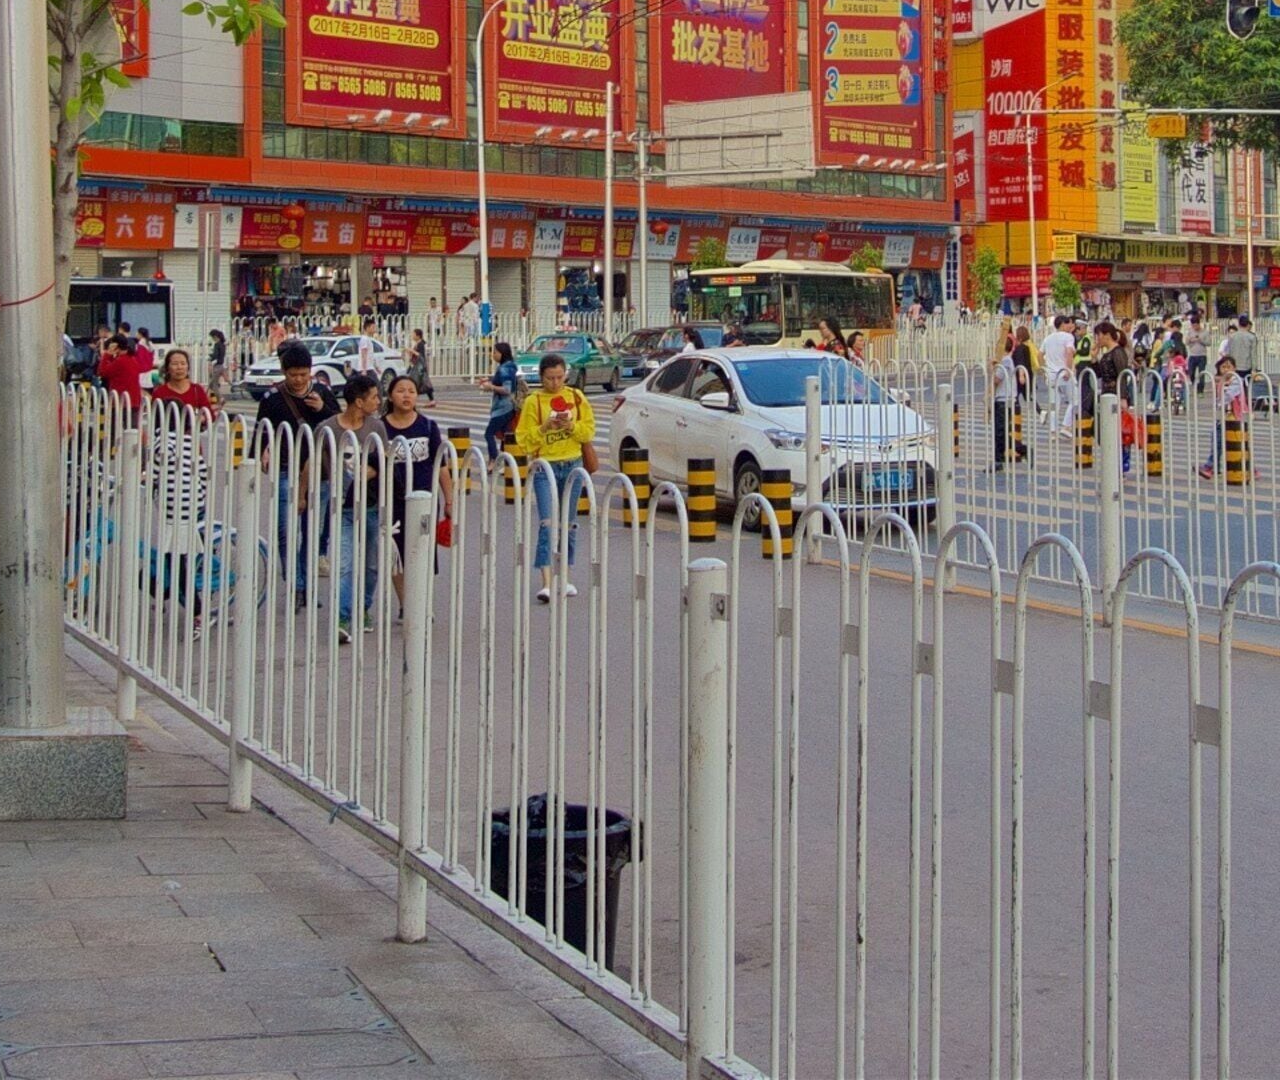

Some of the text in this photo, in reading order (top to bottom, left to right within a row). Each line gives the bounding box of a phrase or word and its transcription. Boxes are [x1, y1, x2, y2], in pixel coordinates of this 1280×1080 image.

[313, 18, 436, 47] 2017年2月16日-2月28日
[672, 19, 770, 73] 批发基地
[824, 21, 840, 56] 2
[990, 58, 1012, 79] 沙河
[824, 66, 840, 101] 3
[114, 213, 166, 239] 六街
[311, 219, 356, 246] 五街
[490, 227, 529, 251] 四街
[1101, 240, 1121, 260] APP
